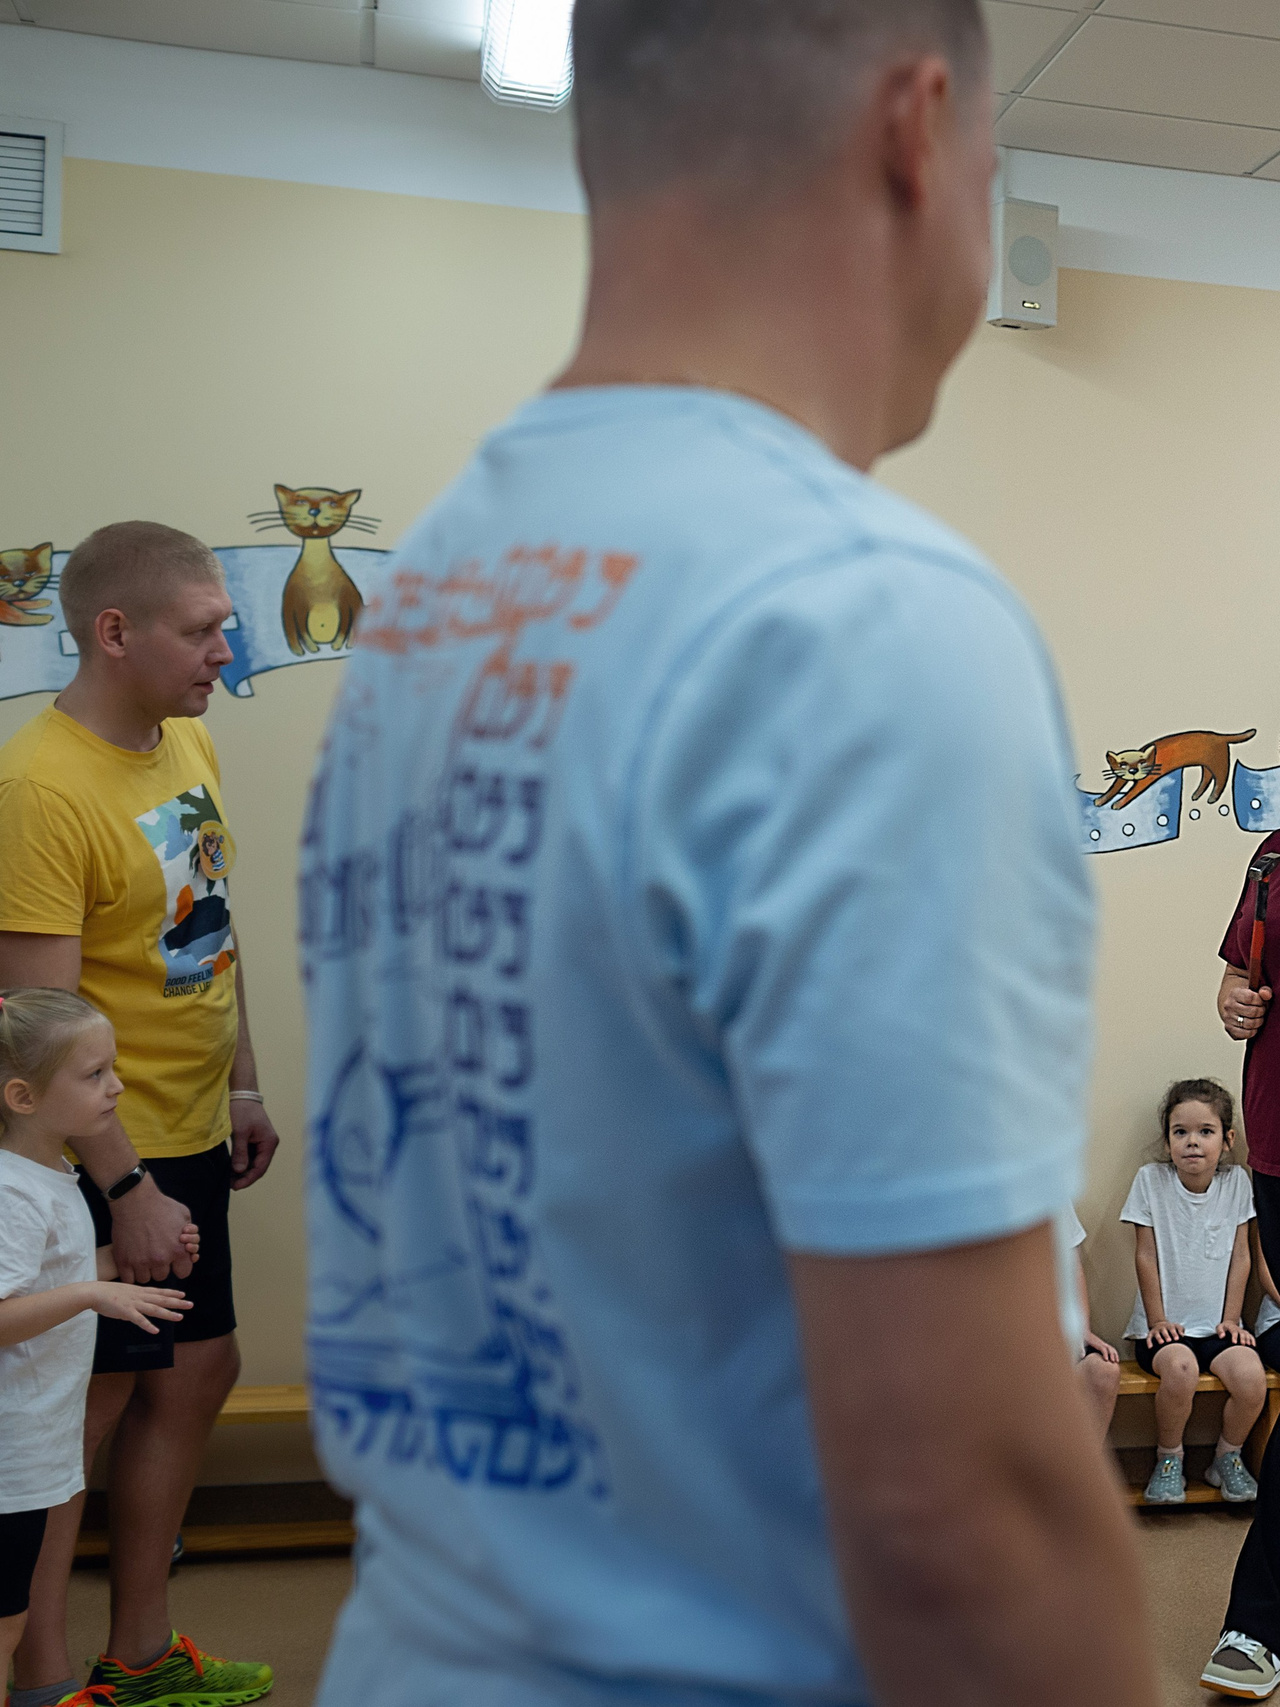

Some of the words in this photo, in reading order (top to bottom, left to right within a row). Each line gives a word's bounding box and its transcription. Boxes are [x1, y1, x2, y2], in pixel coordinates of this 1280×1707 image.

[165, 976, 187, 986] GOOD
[163, 984, 198, 998] CHANGE
[198, 980, 211, 993] LIF
